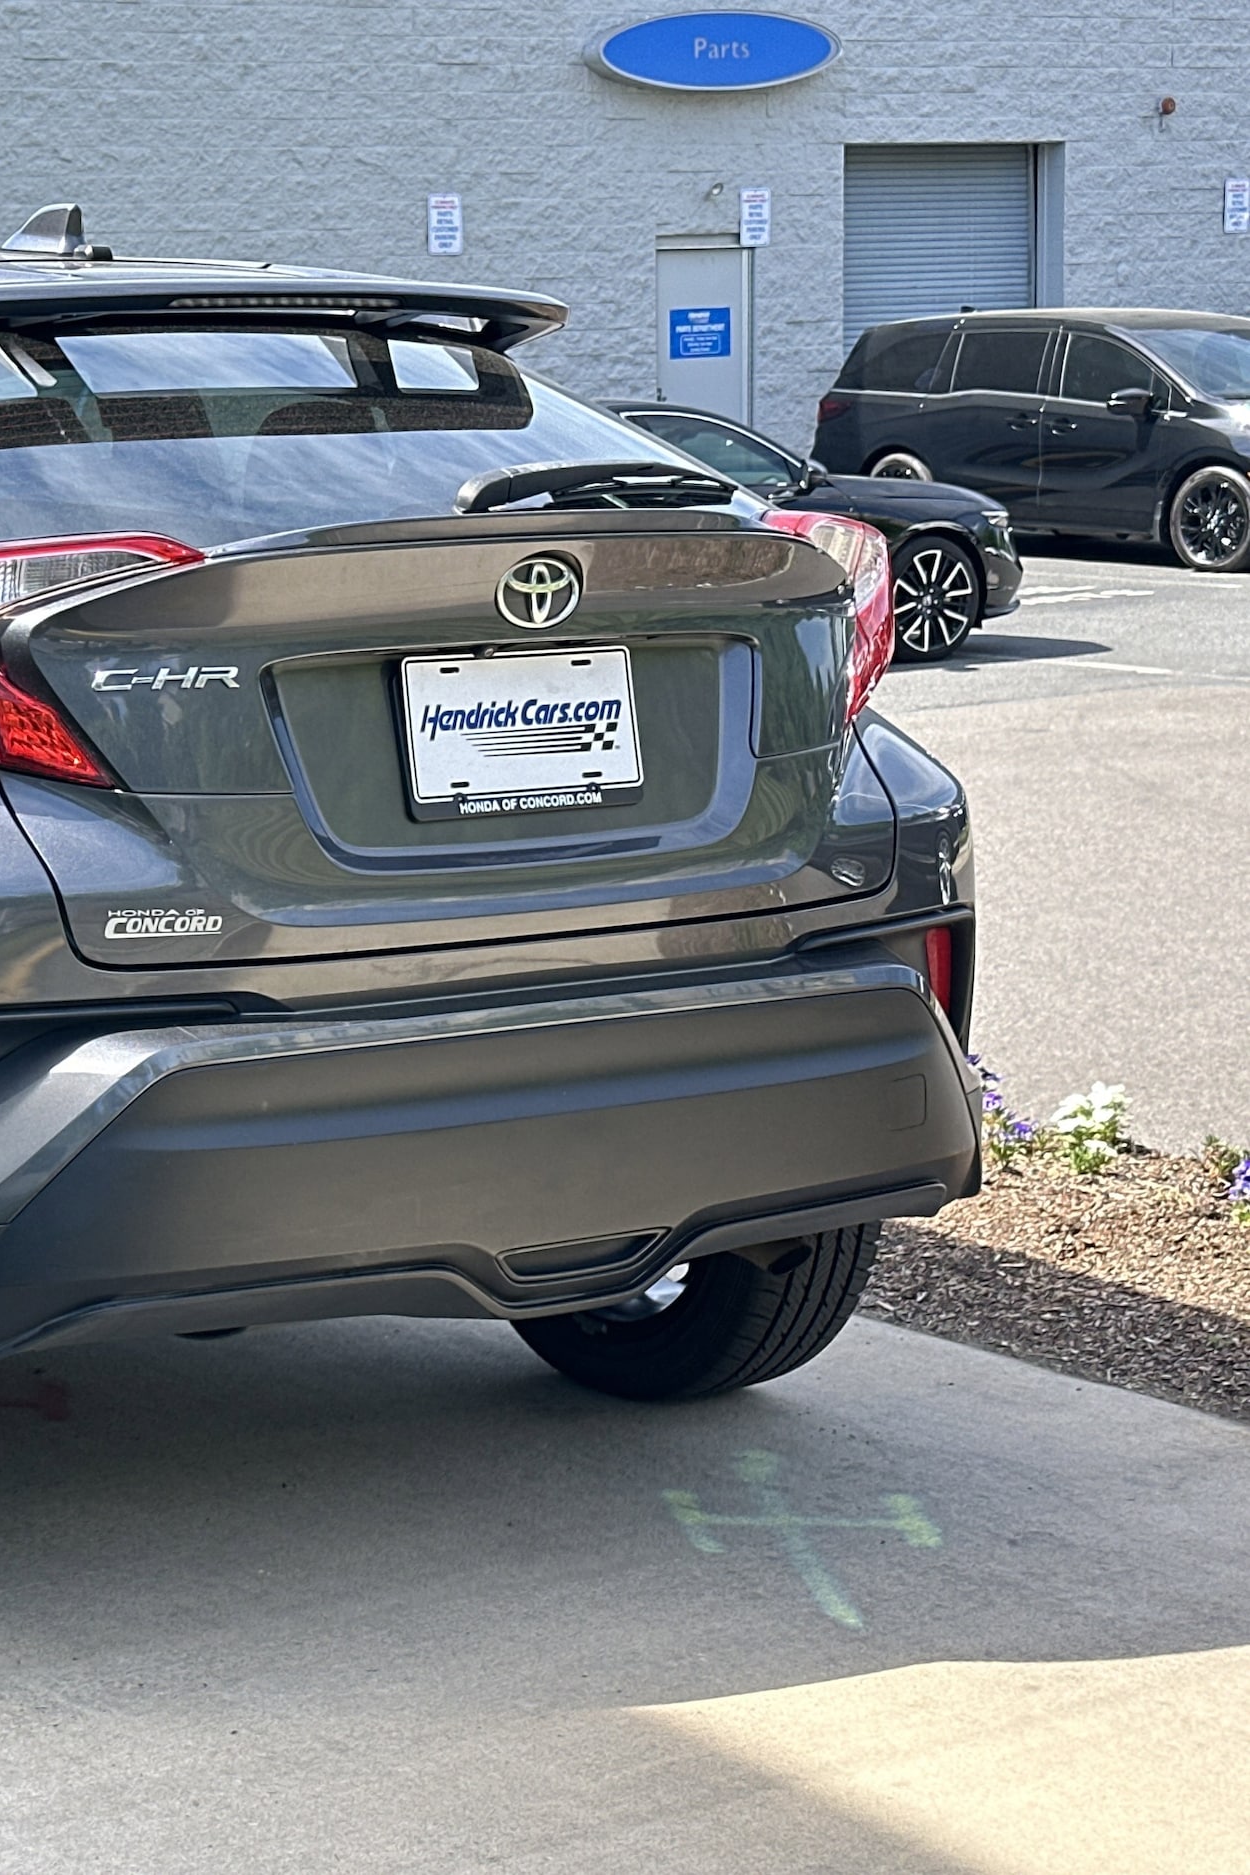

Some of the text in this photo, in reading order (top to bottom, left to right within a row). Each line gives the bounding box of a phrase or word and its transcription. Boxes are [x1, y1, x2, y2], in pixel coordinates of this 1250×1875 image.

[694, 37, 750, 59] Parts
[92, 667, 240, 691] C-HR
[459, 792, 602, 814] HONDA OF CONCORD.COM
[108, 908, 205, 917] HONDA OF
[105, 916, 223, 939] CONCORD
